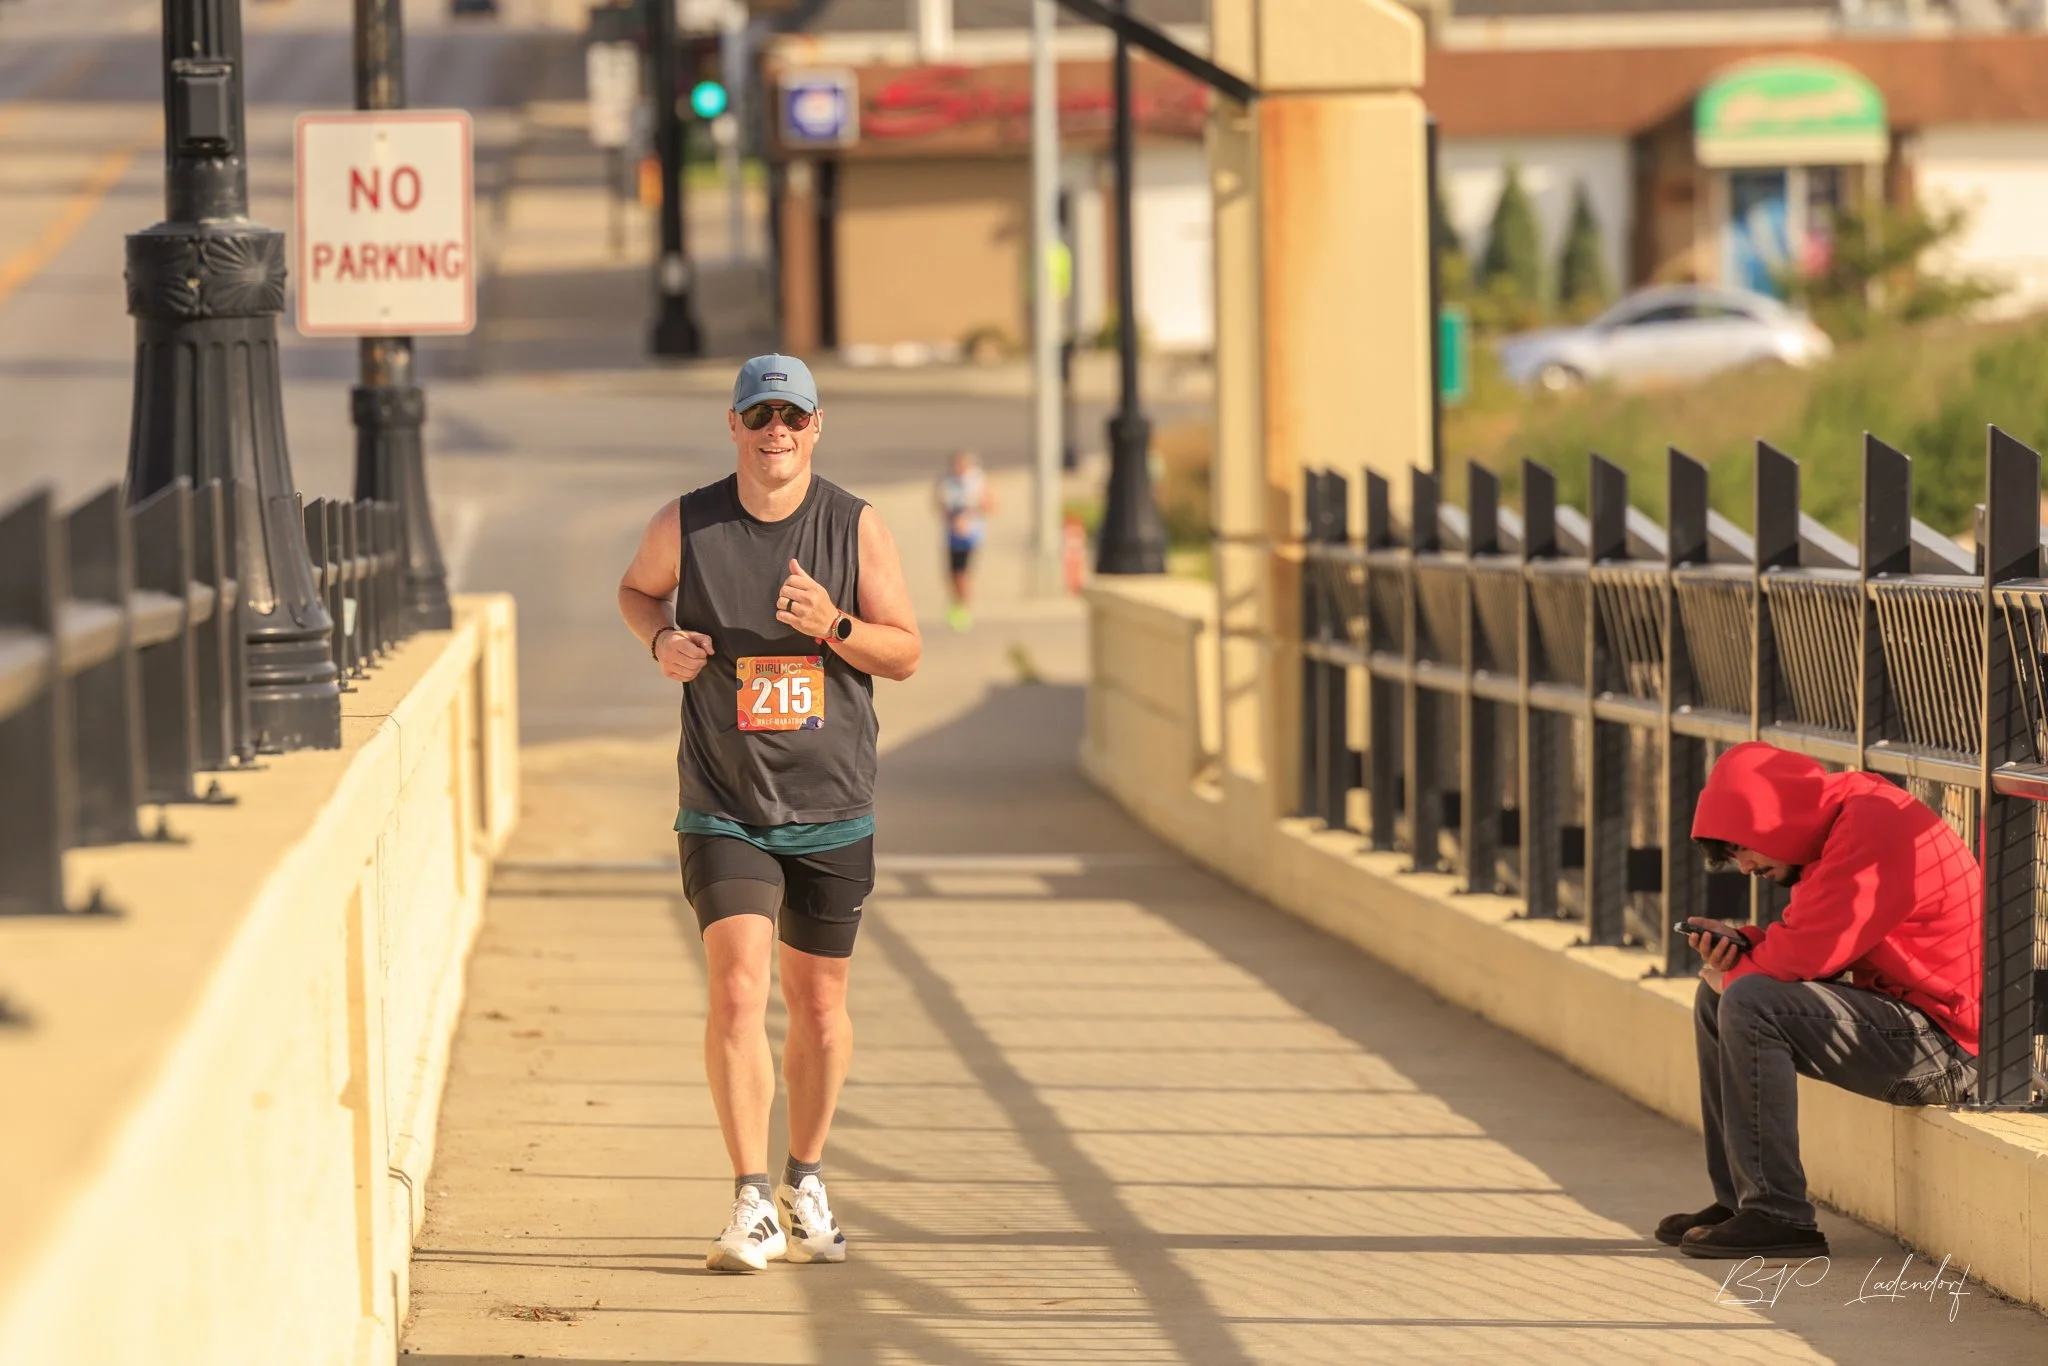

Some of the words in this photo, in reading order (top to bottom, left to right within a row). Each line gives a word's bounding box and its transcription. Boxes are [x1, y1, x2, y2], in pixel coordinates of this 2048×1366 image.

[349, 165, 422, 212] NO
[312, 240, 464, 282] PARKING
[751, 677, 812, 714] 215
[757, 718, 773, 726] HALF
